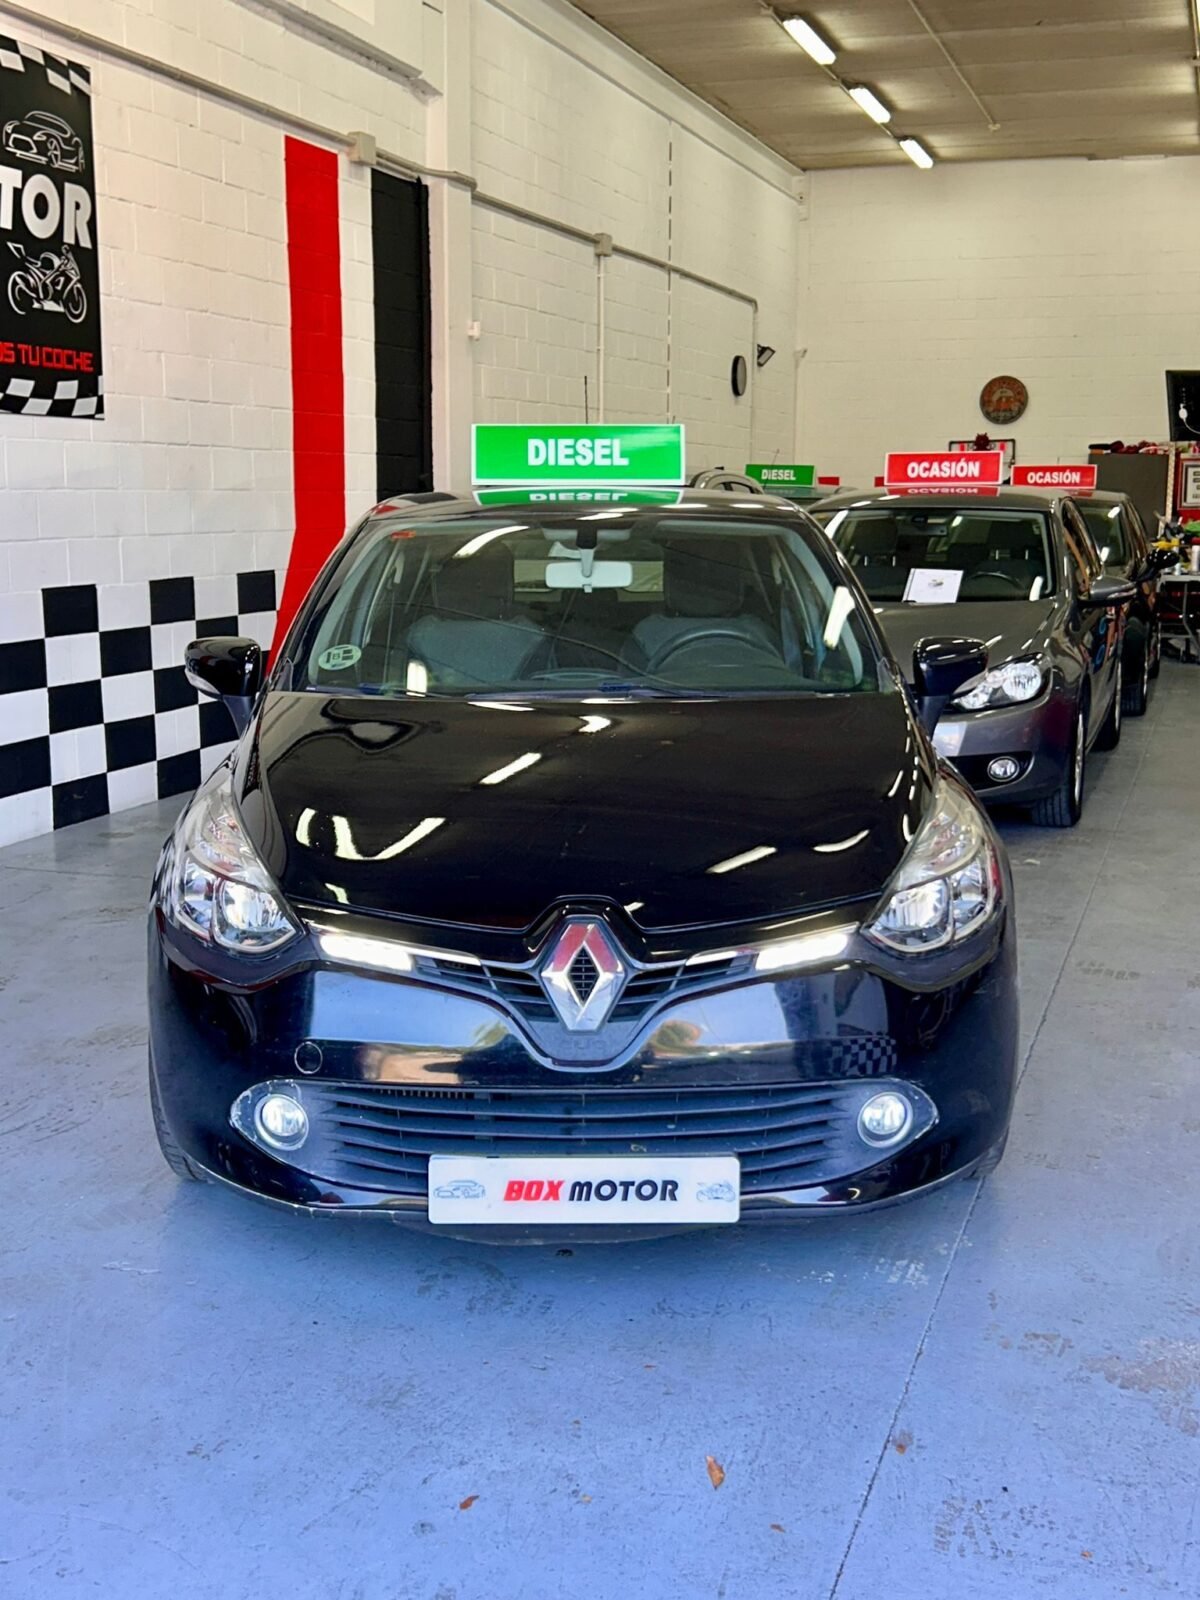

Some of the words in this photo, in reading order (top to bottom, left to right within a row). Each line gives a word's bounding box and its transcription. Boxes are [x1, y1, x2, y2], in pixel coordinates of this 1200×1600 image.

[17, 343, 40, 366] TU
[42, 346, 94, 372] COCHE
[527, 438, 630, 466] DIESEL
[761, 469, 797, 480] DIESEL
[907, 457, 980, 478] OCASIÓN
[1027, 469, 1081, 484] OCASIÓN
[503, 1180, 565, 1201] BOX
[568, 1179, 679, 1202] MOTOR
